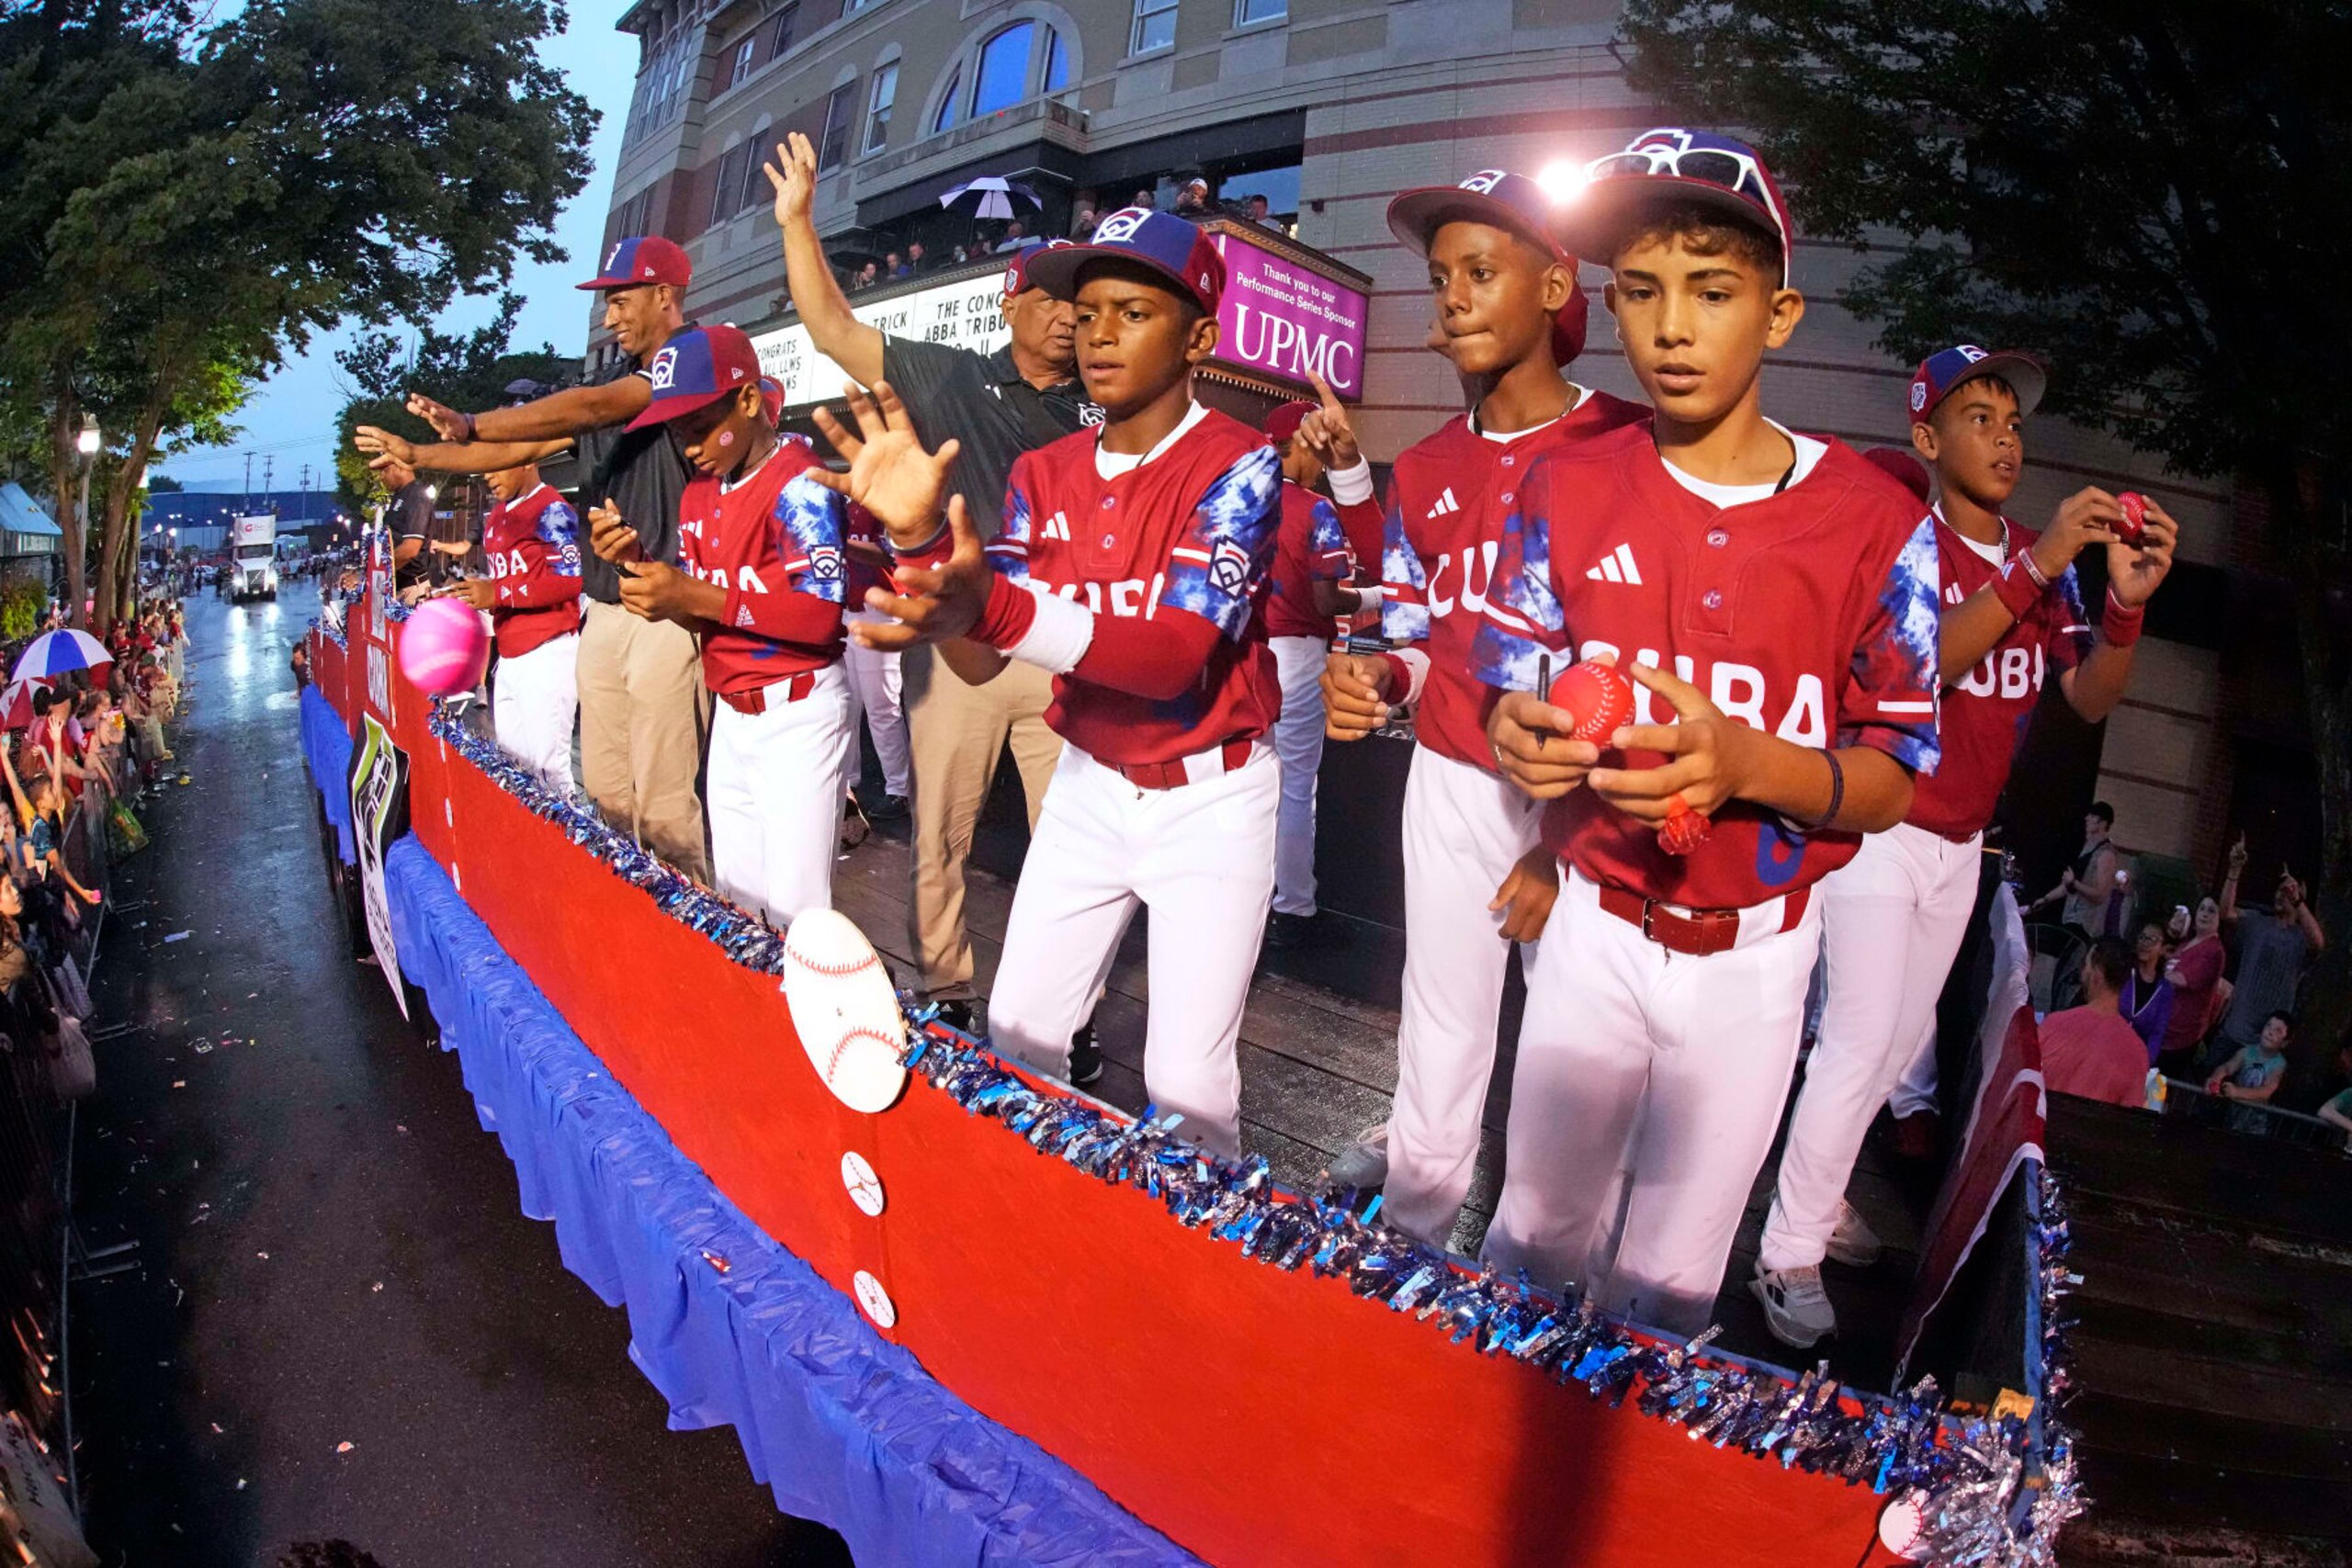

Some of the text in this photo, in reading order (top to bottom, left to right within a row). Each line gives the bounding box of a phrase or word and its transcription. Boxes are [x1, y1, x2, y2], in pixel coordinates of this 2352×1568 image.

[1263, 263, 1335, 304] Thank you to our
[938, 299, 960, 320] THE
[1237, 271, 1356, 331] Performance Series Sponsor
[924, 321, 956, 344] ABBA
[1235, 302, 1354, 389] UPMC
[757, 339, 797, 361] CONGRATS
